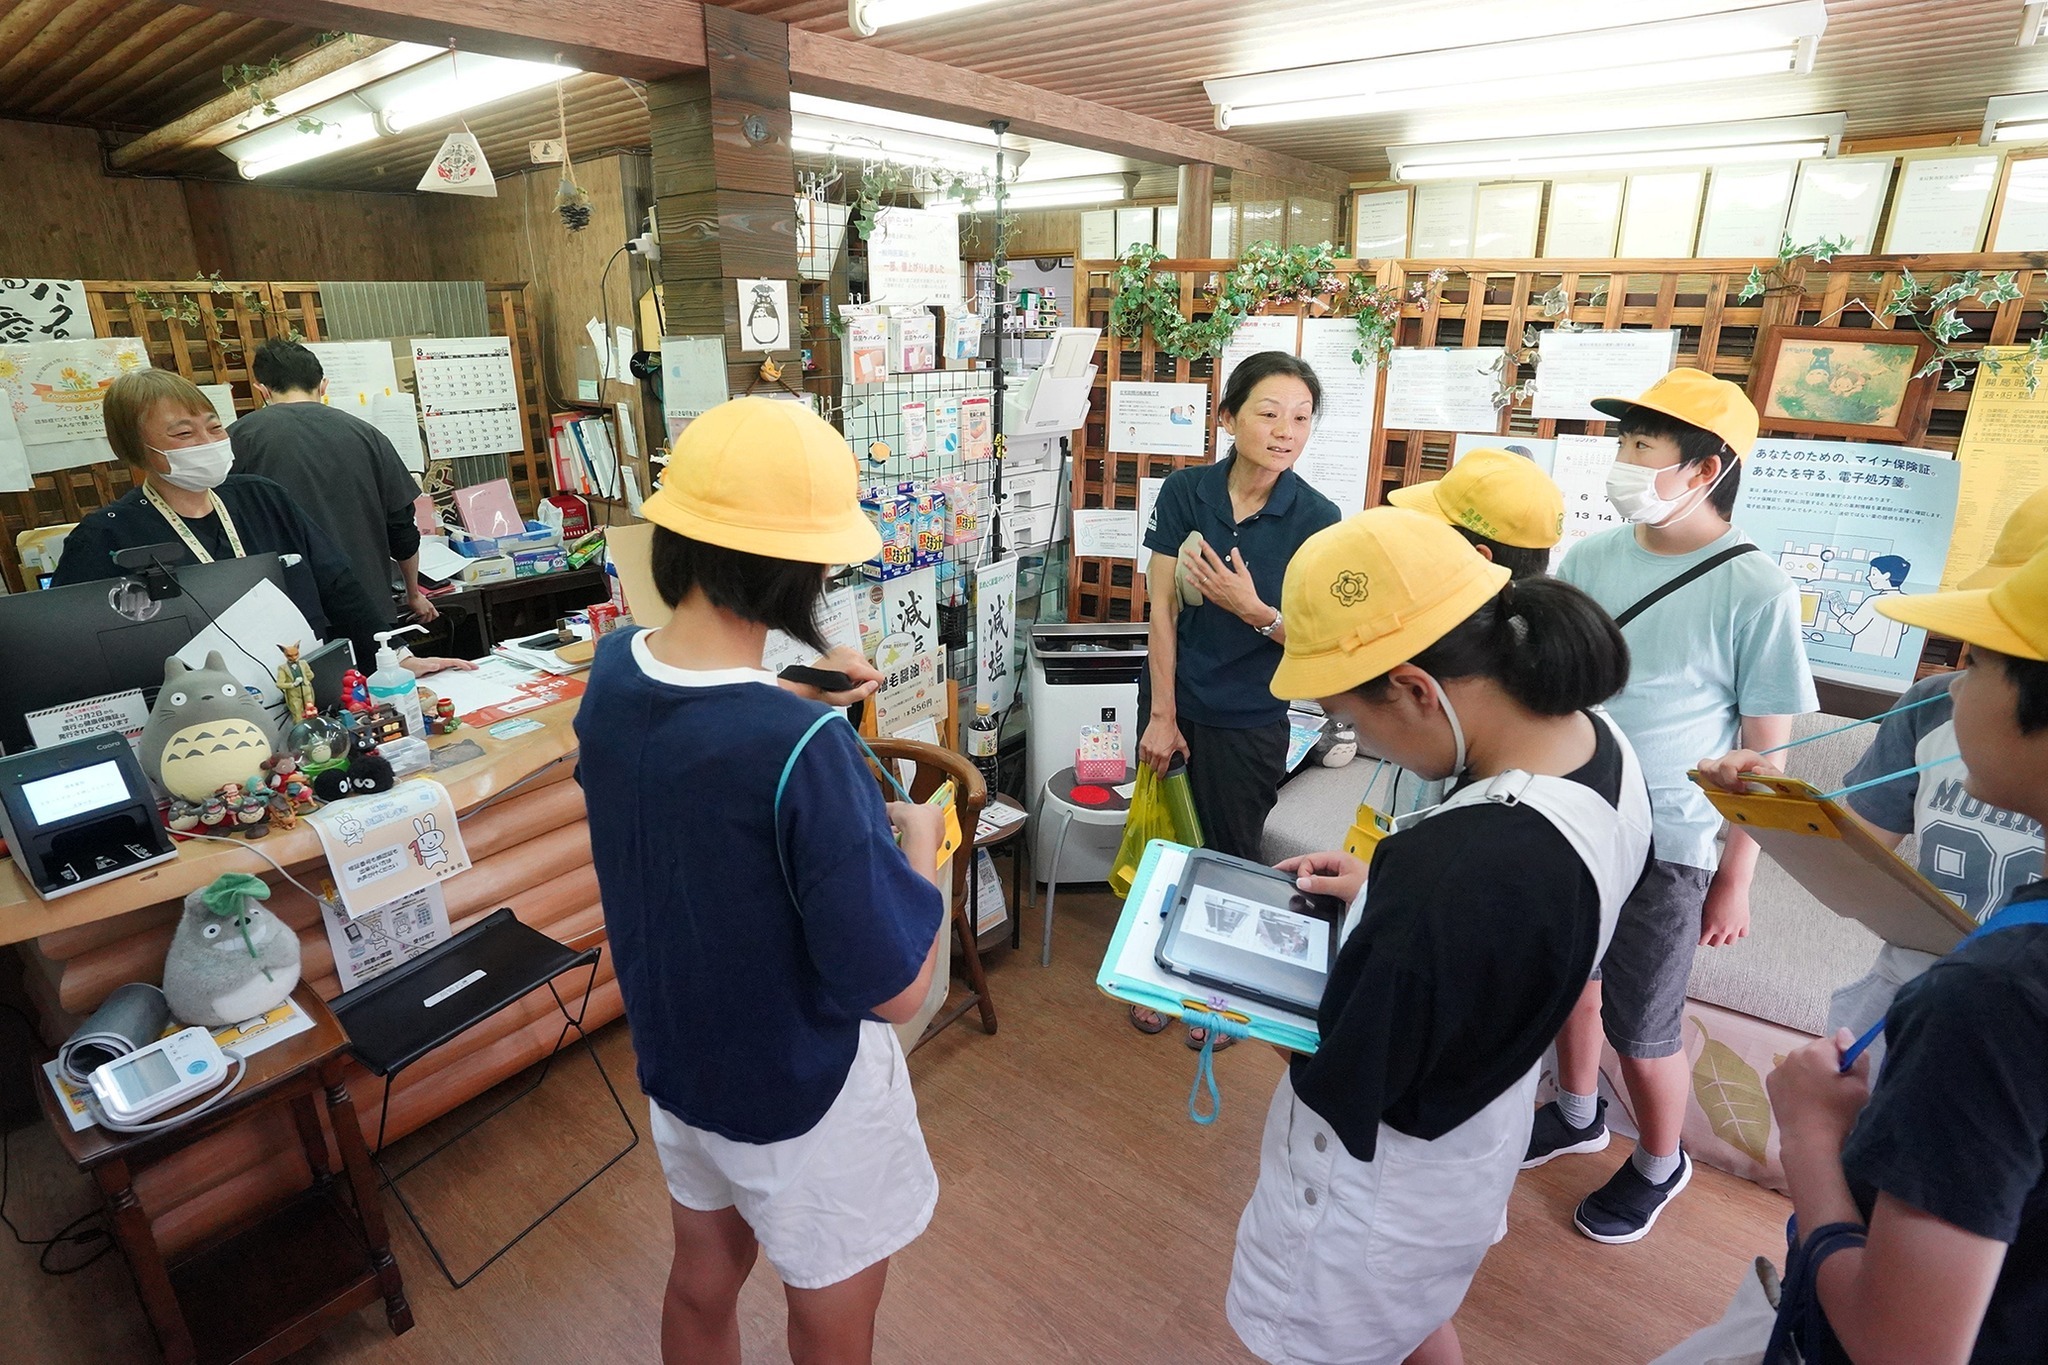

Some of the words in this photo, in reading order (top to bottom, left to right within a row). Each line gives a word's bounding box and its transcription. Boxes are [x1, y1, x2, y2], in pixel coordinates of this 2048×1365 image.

[417, 348, 423, 356] 8
[55, 404, 103, 412] プロジェク
[1756, 448, 1937, 477] あなたのための、マイナ保険証。
[1752, 466, 1911, 489] あなたを守る、電子処方箋。
[988, 594, 1009, 682] 減塩
[58, 718, 129, 740] 発行されなくなります
